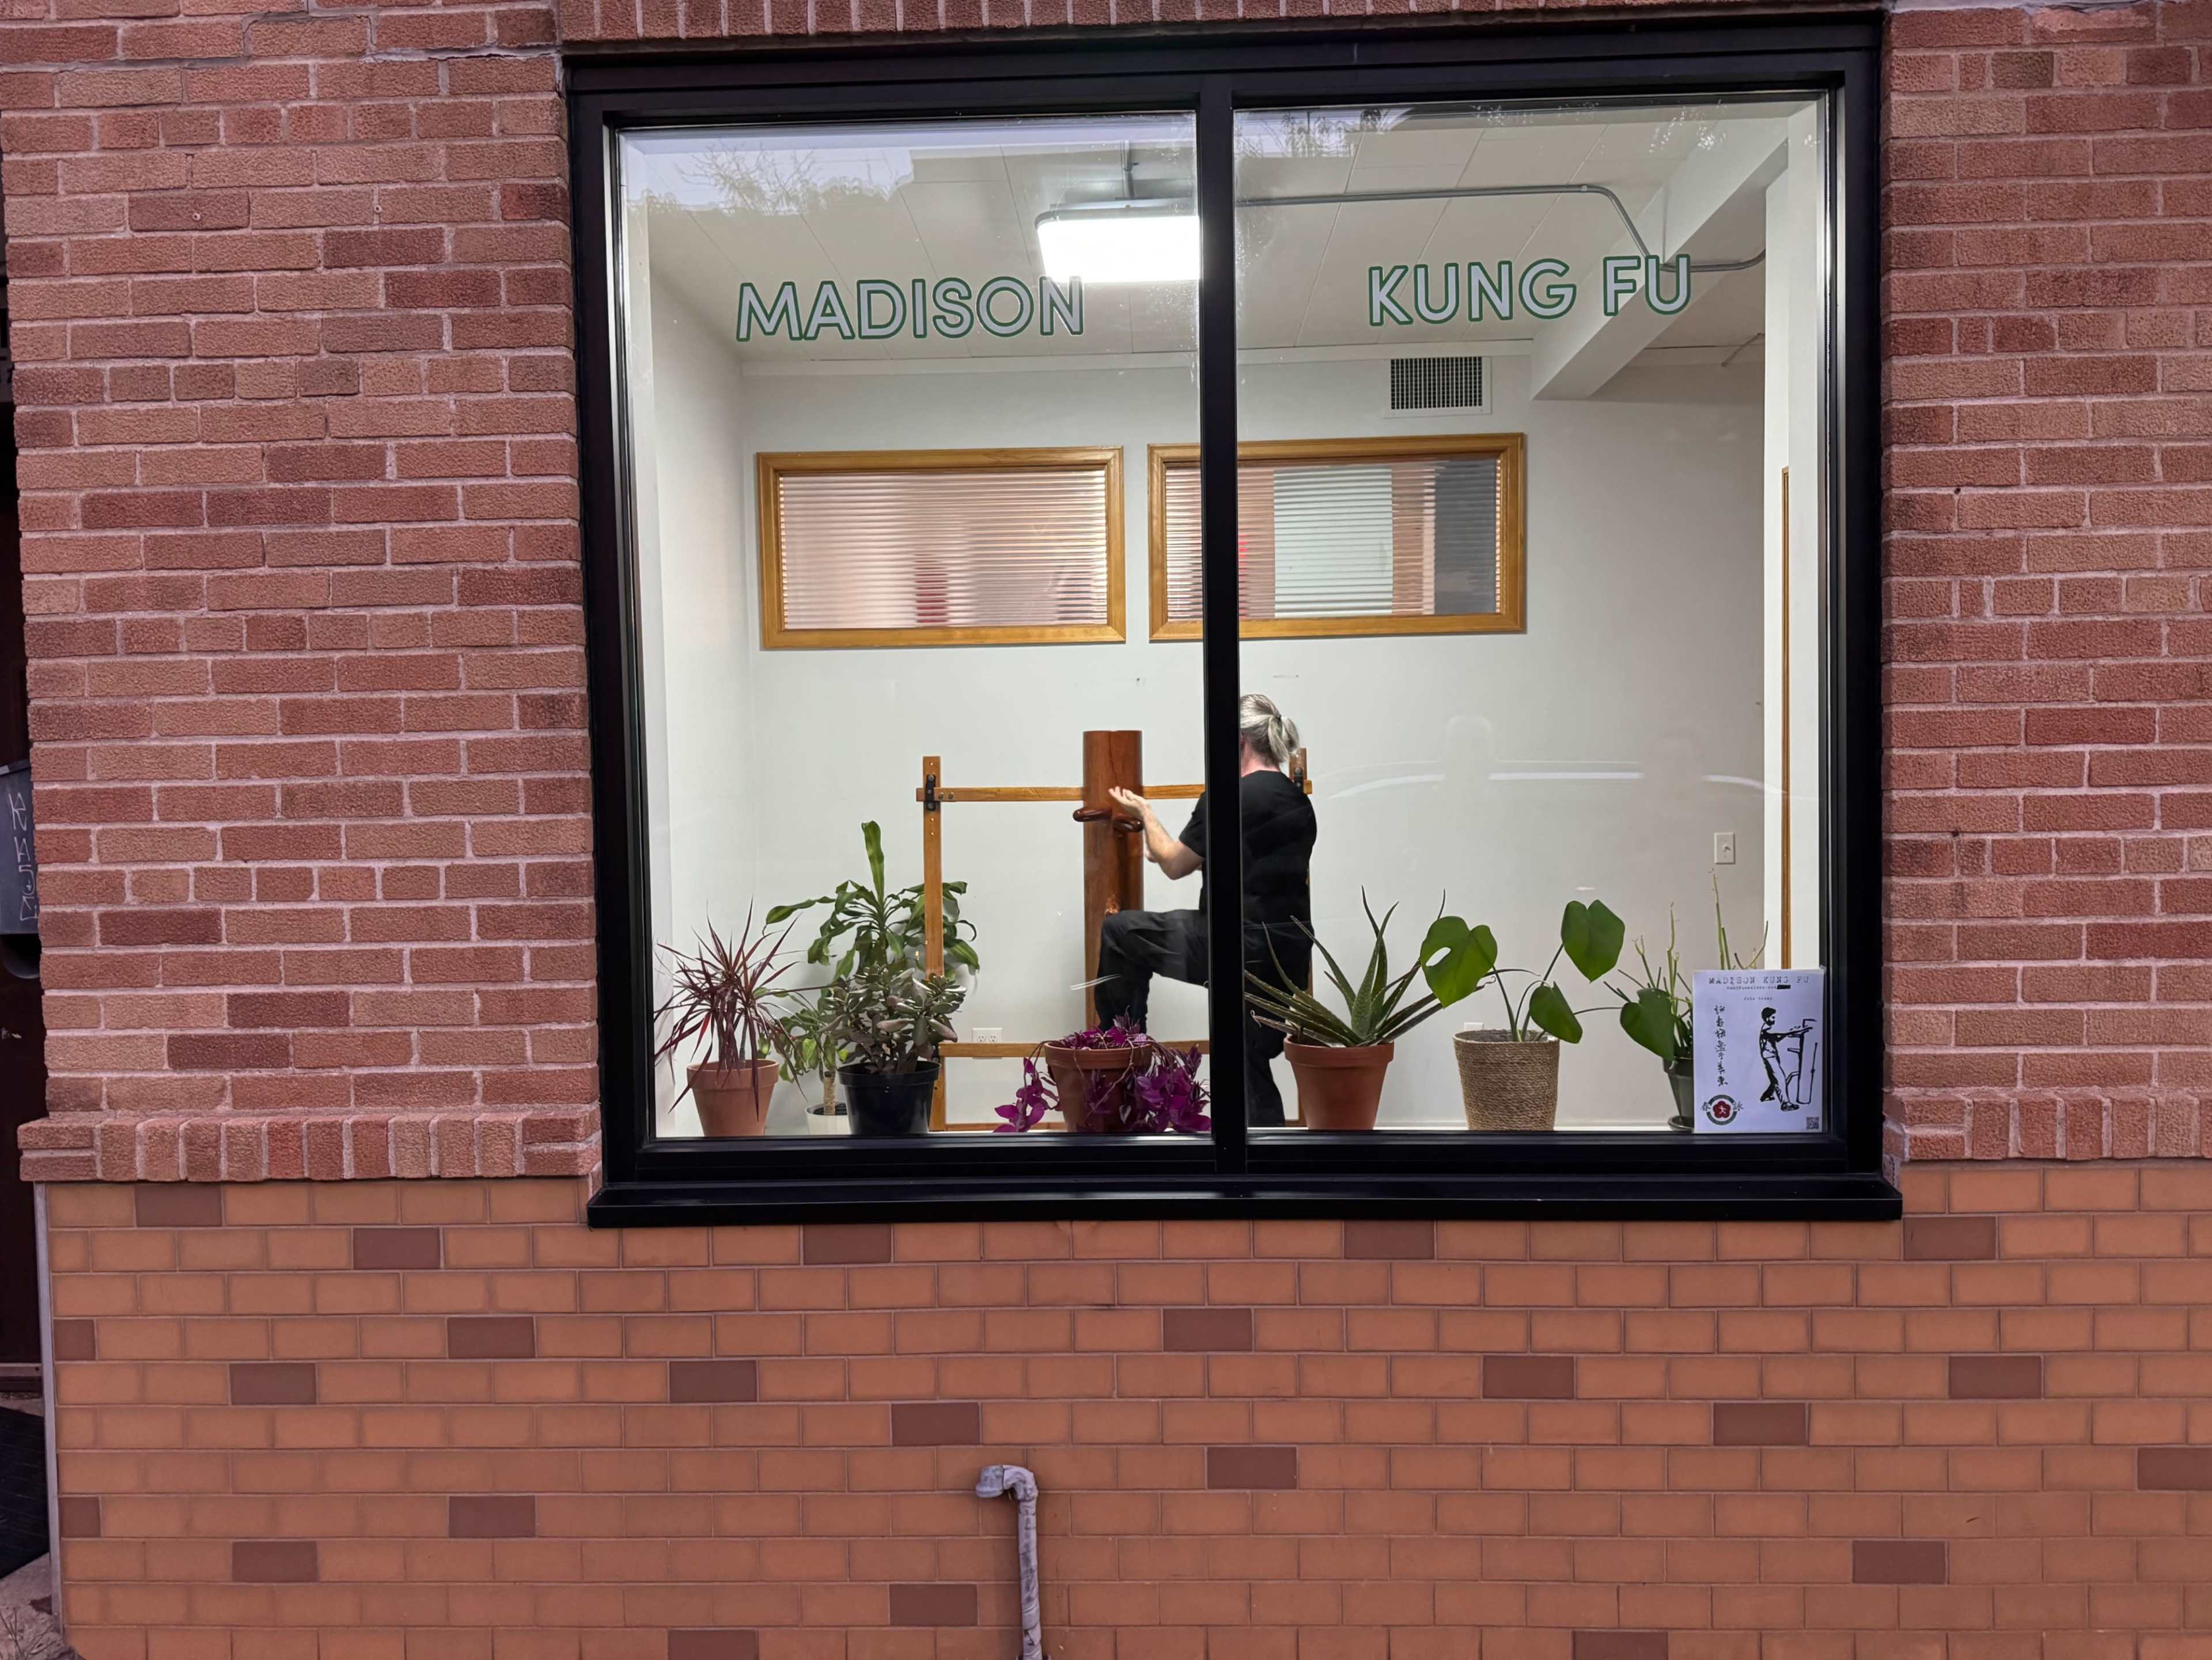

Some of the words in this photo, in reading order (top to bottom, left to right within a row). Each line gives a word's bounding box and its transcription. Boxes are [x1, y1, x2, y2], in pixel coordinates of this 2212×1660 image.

[736, 276, 1084, 341] MADISON
[1369, 258, 1577, 326] KUNG
[1603, 254, 1691, 316] FU
[1709, 977, 1756, 985] MADISON
